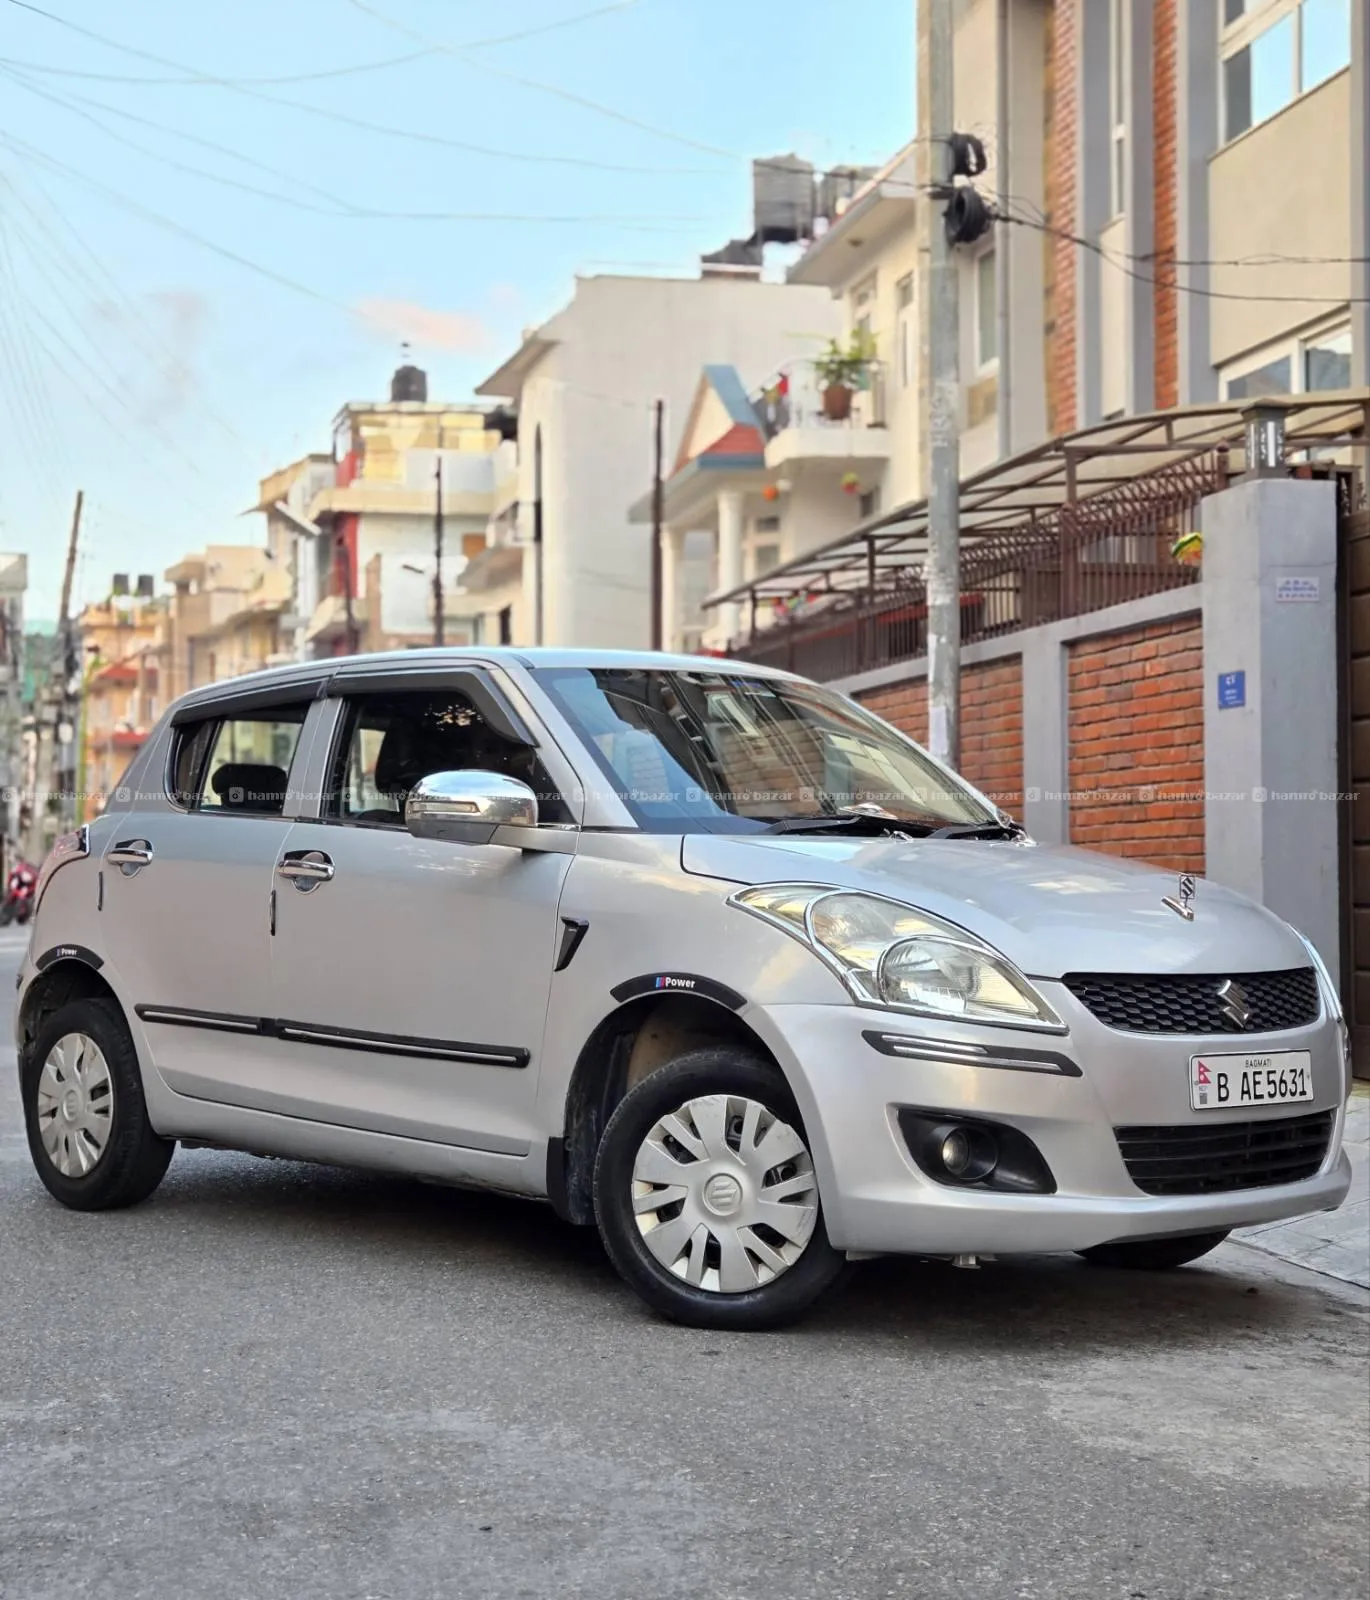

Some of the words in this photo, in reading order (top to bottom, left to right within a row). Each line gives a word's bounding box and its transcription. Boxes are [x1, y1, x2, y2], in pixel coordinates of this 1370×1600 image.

[665, 976, 696, 989] Power
[1244, 1058, 1272, 1069] BAGMATI
[1217, 1072, 1230, 1103] B
[1240, 1068, 1307, 1101] AE5631
